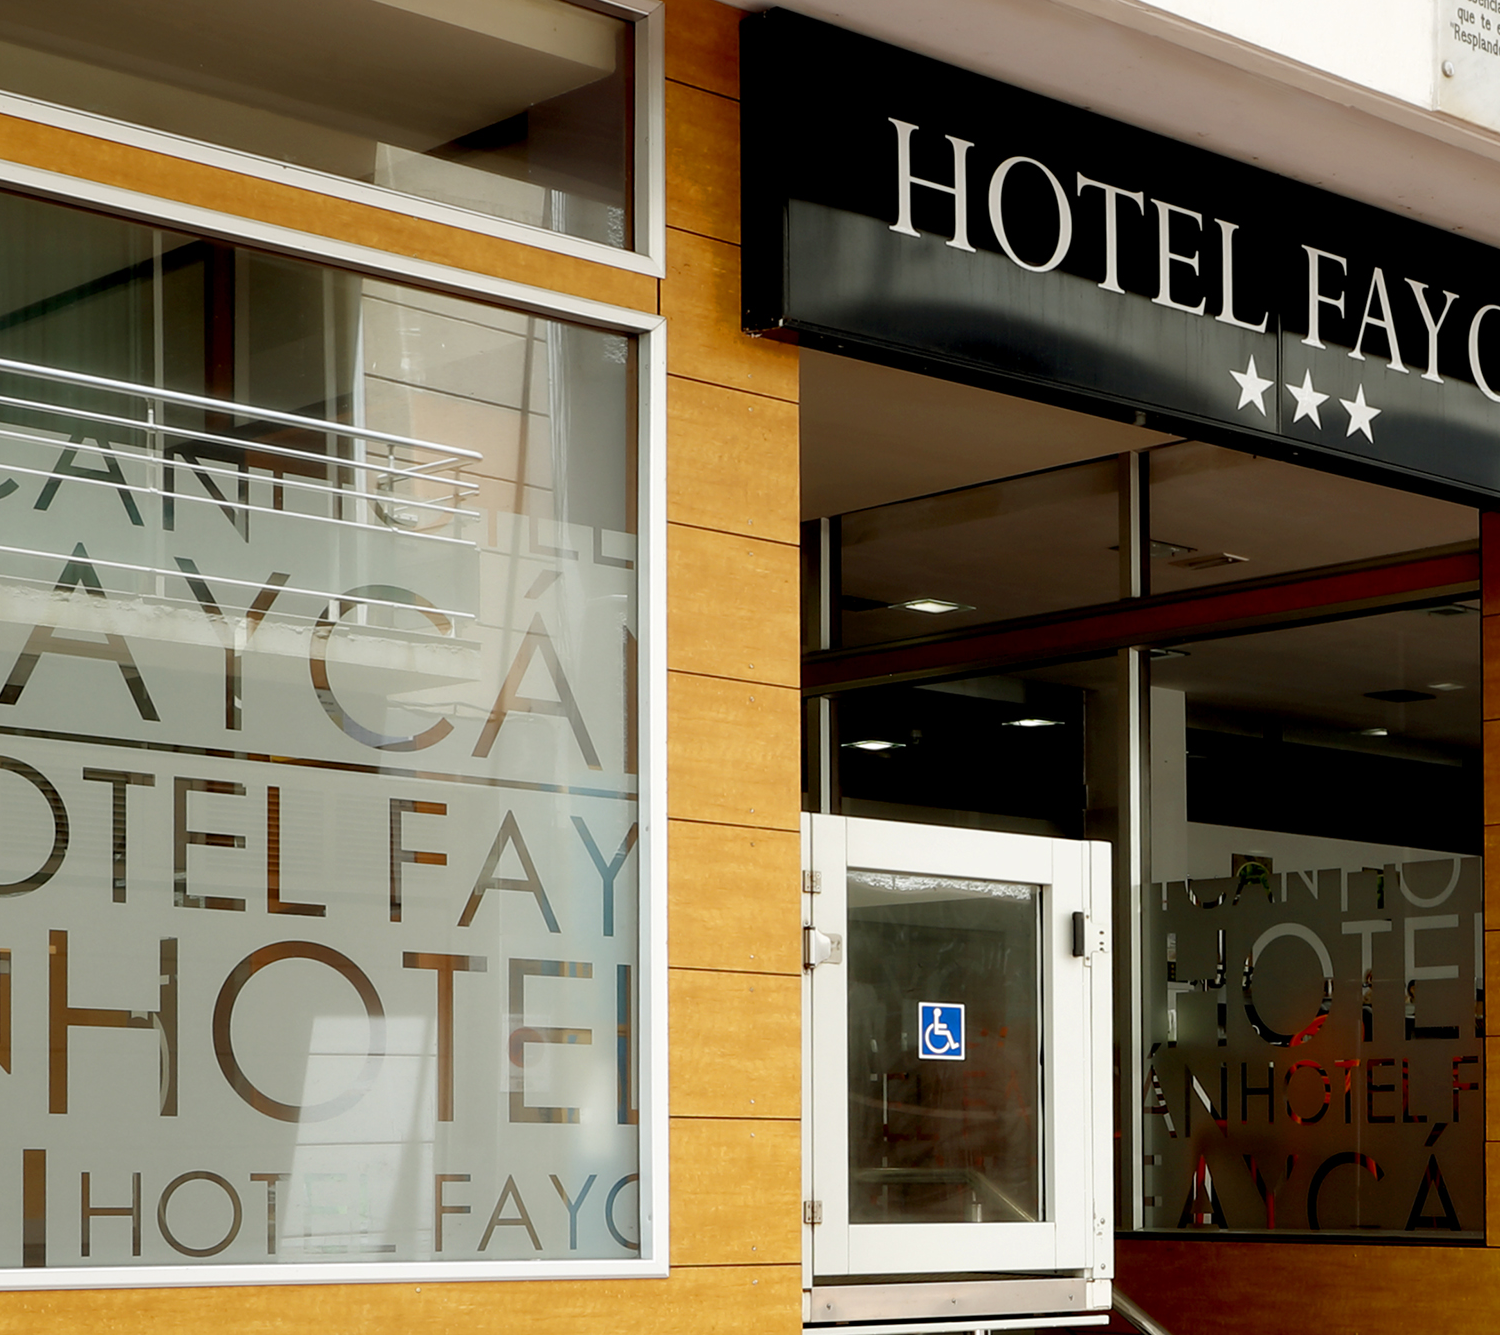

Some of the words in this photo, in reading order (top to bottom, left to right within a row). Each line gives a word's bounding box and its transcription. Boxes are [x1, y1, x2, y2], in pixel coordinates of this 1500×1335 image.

[1456, 7, 1476, 25] que
[1479, 13, 1492, 31] te
[887, 117, 1268, 334] HOTEL
[389, 797, 639, 937] FAY
[1240, 1057, 1429, 1125] HOTEL
